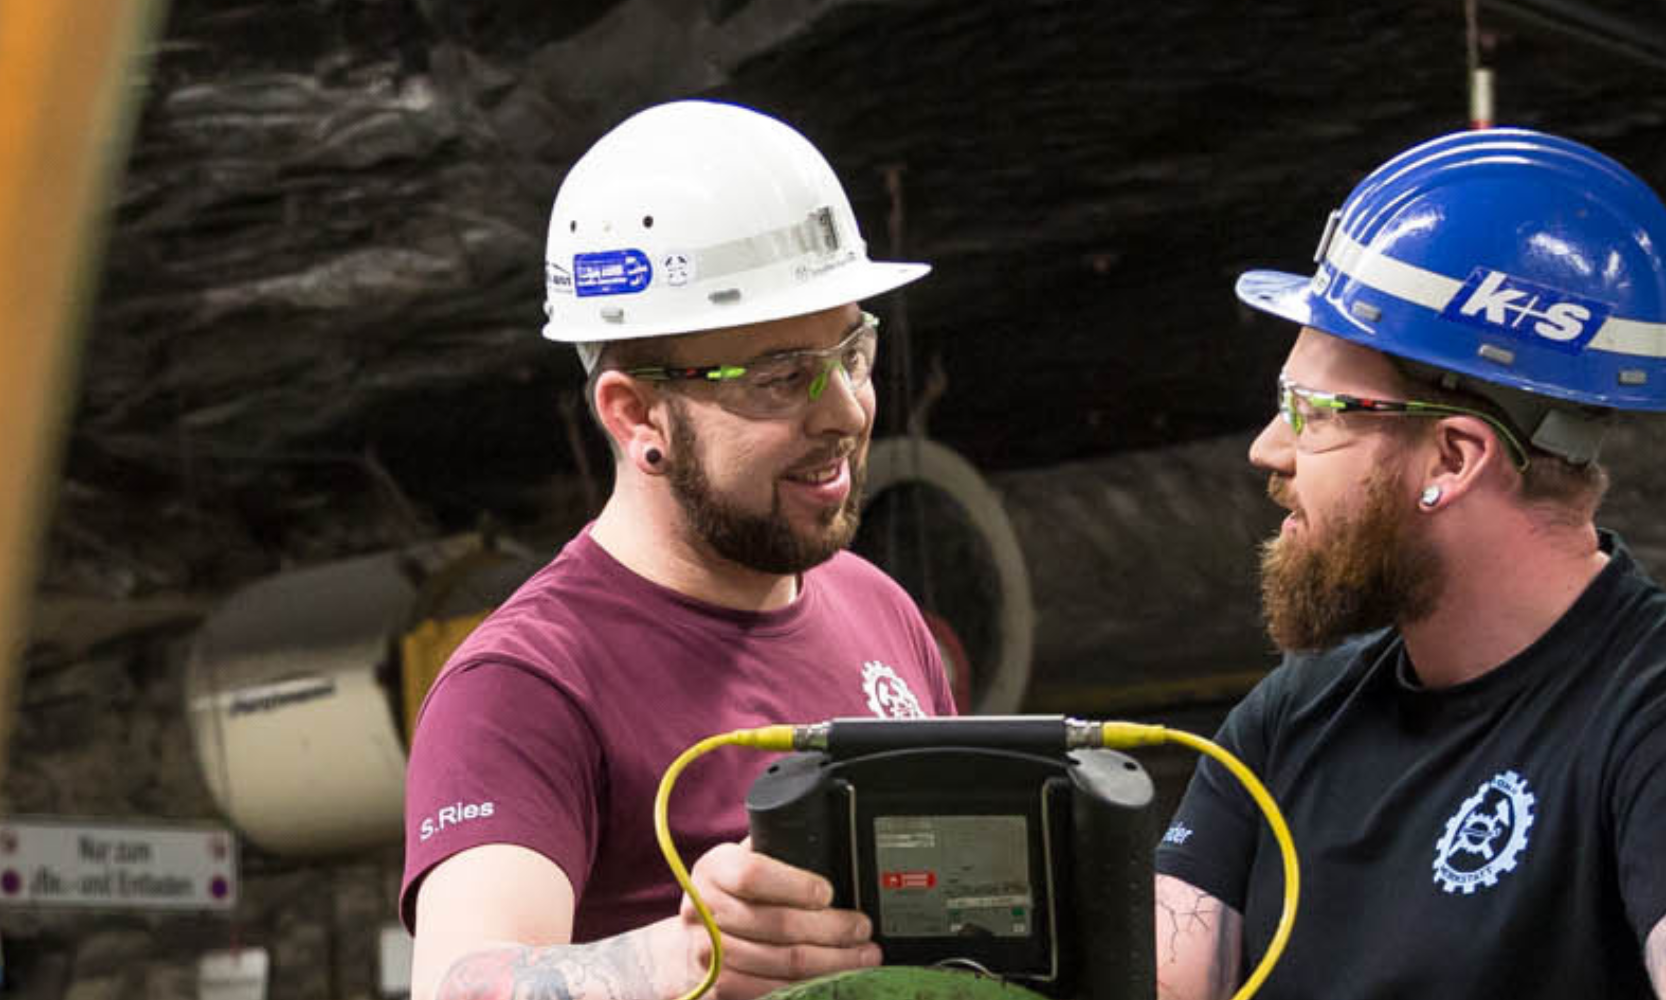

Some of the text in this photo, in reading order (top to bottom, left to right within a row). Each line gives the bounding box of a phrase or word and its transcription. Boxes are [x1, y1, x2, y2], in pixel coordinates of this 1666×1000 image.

[420, 802, 494, 842] S.Ries
[78, 834, 152, 865] Nur zum
[79, 867, 112, 896] und
